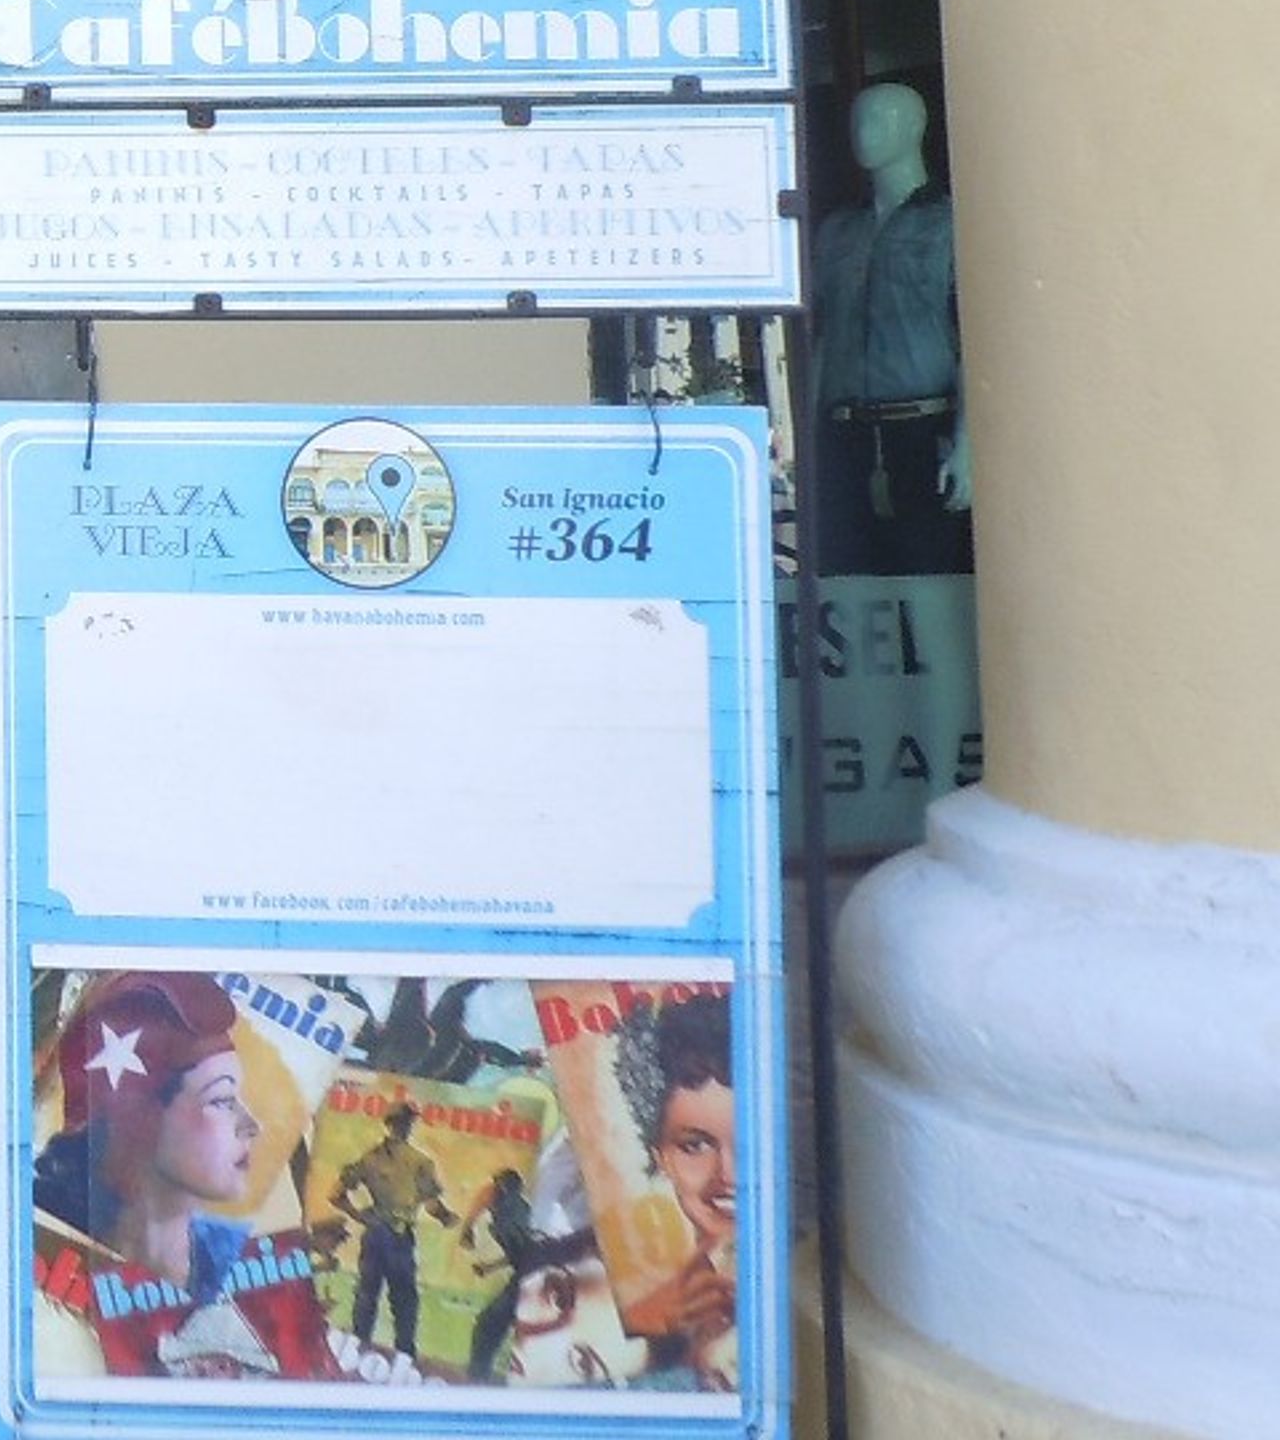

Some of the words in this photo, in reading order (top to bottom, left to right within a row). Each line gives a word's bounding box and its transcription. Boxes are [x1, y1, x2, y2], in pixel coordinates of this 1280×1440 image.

[42, 147, 229, 178] PANINIS
[268, 145, 490, 177] COCTELES
[527, 144, 686, 175] TAPAS
[90, 186, 225, 204] PANINIS
[287, 185, 468, 203] COCKTAILS
[532, 183, 635, 201] TAPAS
[161, 210, 433, 241] ENSALADAS
[473, 208, 747, 239] APERITIVOS
[29, 253, 138, 270] JUICES
[199, 252, 302, 269] TASTY
[69, 485, 248, 517] PLAZA
[501, 485, 554, 509] San
[562, 485, 666, 516] Ignacio
[82, 523, 236, 559] VIEJA
[507, 517, 653, 562] #364
[261, 608, 485, 626] wwwhavanabohemiacom
[201, 891, 555, 914] wwwfacebookcom/cafebohemiahavana
